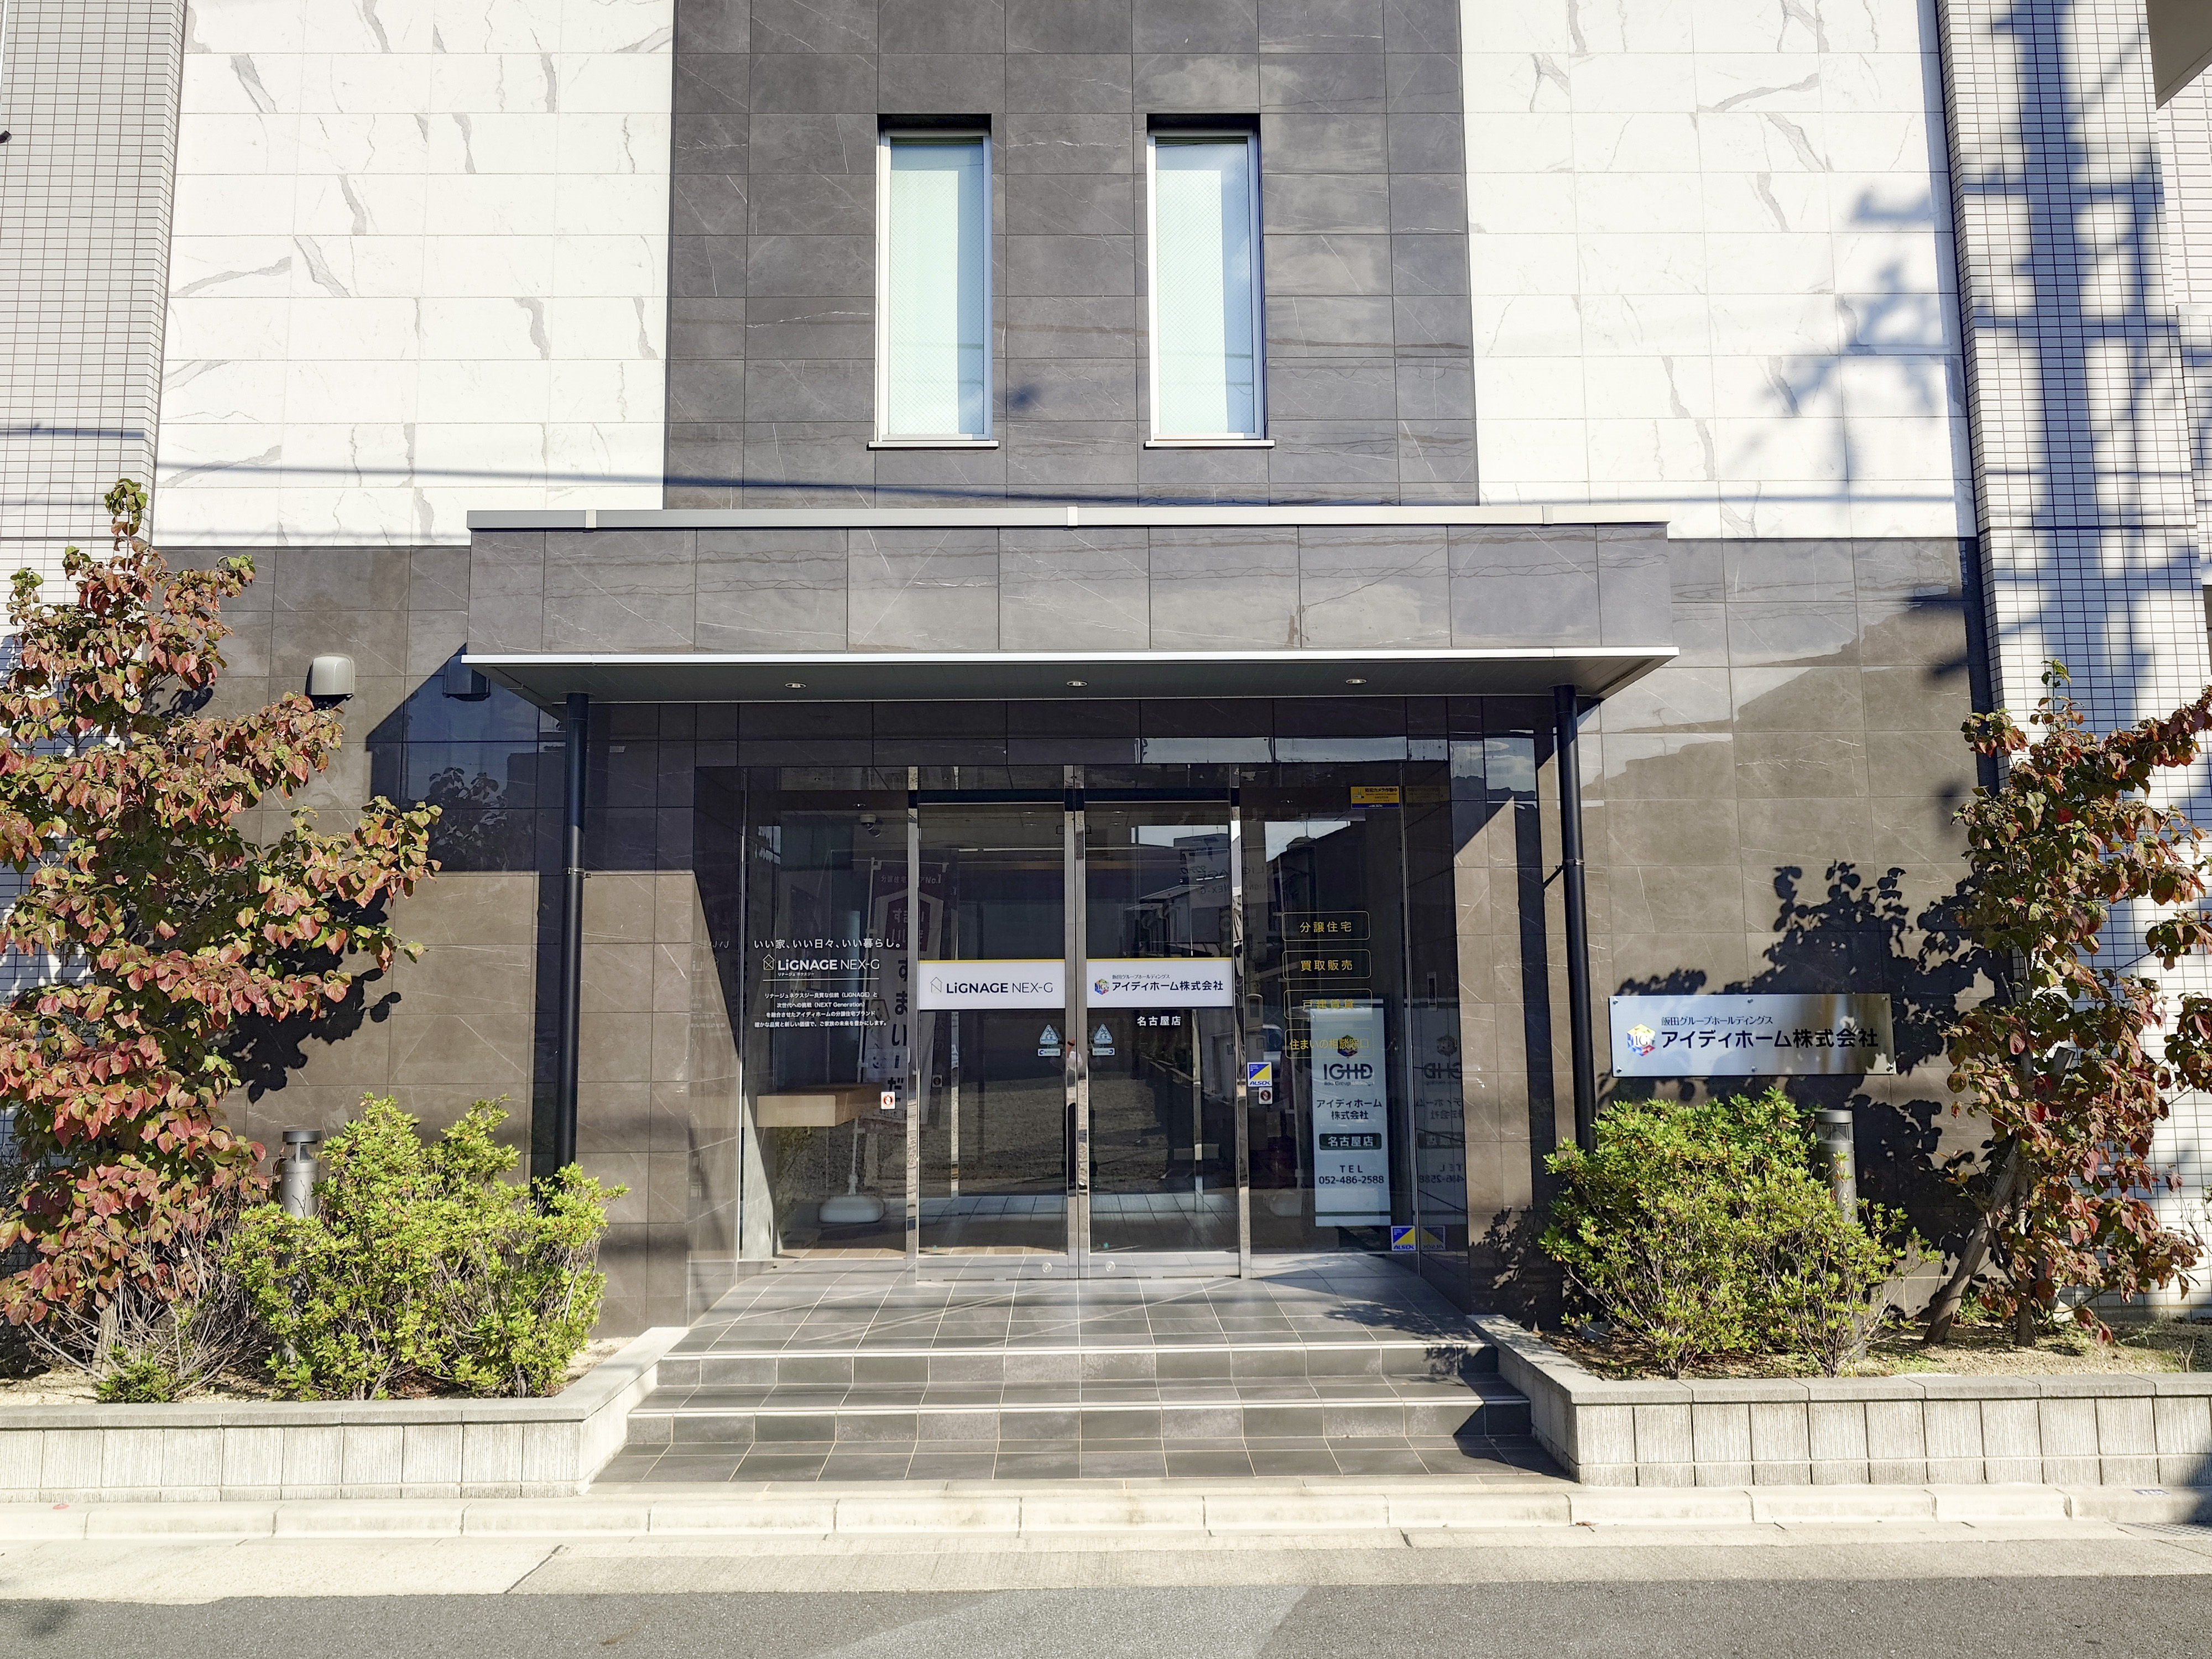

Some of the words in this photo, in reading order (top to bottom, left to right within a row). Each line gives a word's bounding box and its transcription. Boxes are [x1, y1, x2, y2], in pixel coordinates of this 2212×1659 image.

[1300, 921, 1352, 933] 分譲住宅
[754, 938, 901, 949] いい家、いい日々、いい暮らし。
[778, 959, 838, 971] LiGNAGE
[840, 958, 880, 970] NEX-G
[1301, 959, 1353, 972] 買取販売
[946, 982, 1008, 994] LiGNAGE
[1012, 982, 1053, 993] NEX-G
[1112, 980, 1224, 991] アイディホーム株式会社
[1302, 999, 1354, 1010] 戸建賃貸
[1137, 1015, 1181, 1026] 名古屋店
[1661, 1016, 1773, 1026] 飯田グループホールディングス
[1661, 1029, 1879, 1048] アイディホーム株式会社
[1289, 1039, 1370, 1050] 住まいの相談窓口
[1323, 1063, 1373, 1079] IGHD
[1317, 1098, 1383, 1108] アイディホーム
[1331, 1110, 1369, 1120] 株式会社
[1328, 1136, 1374, 1147] 名古屋店
[1339, 1165, 1363, 1173] TEL
[1318, 1176, 1384, 1185] 052-486-2588
